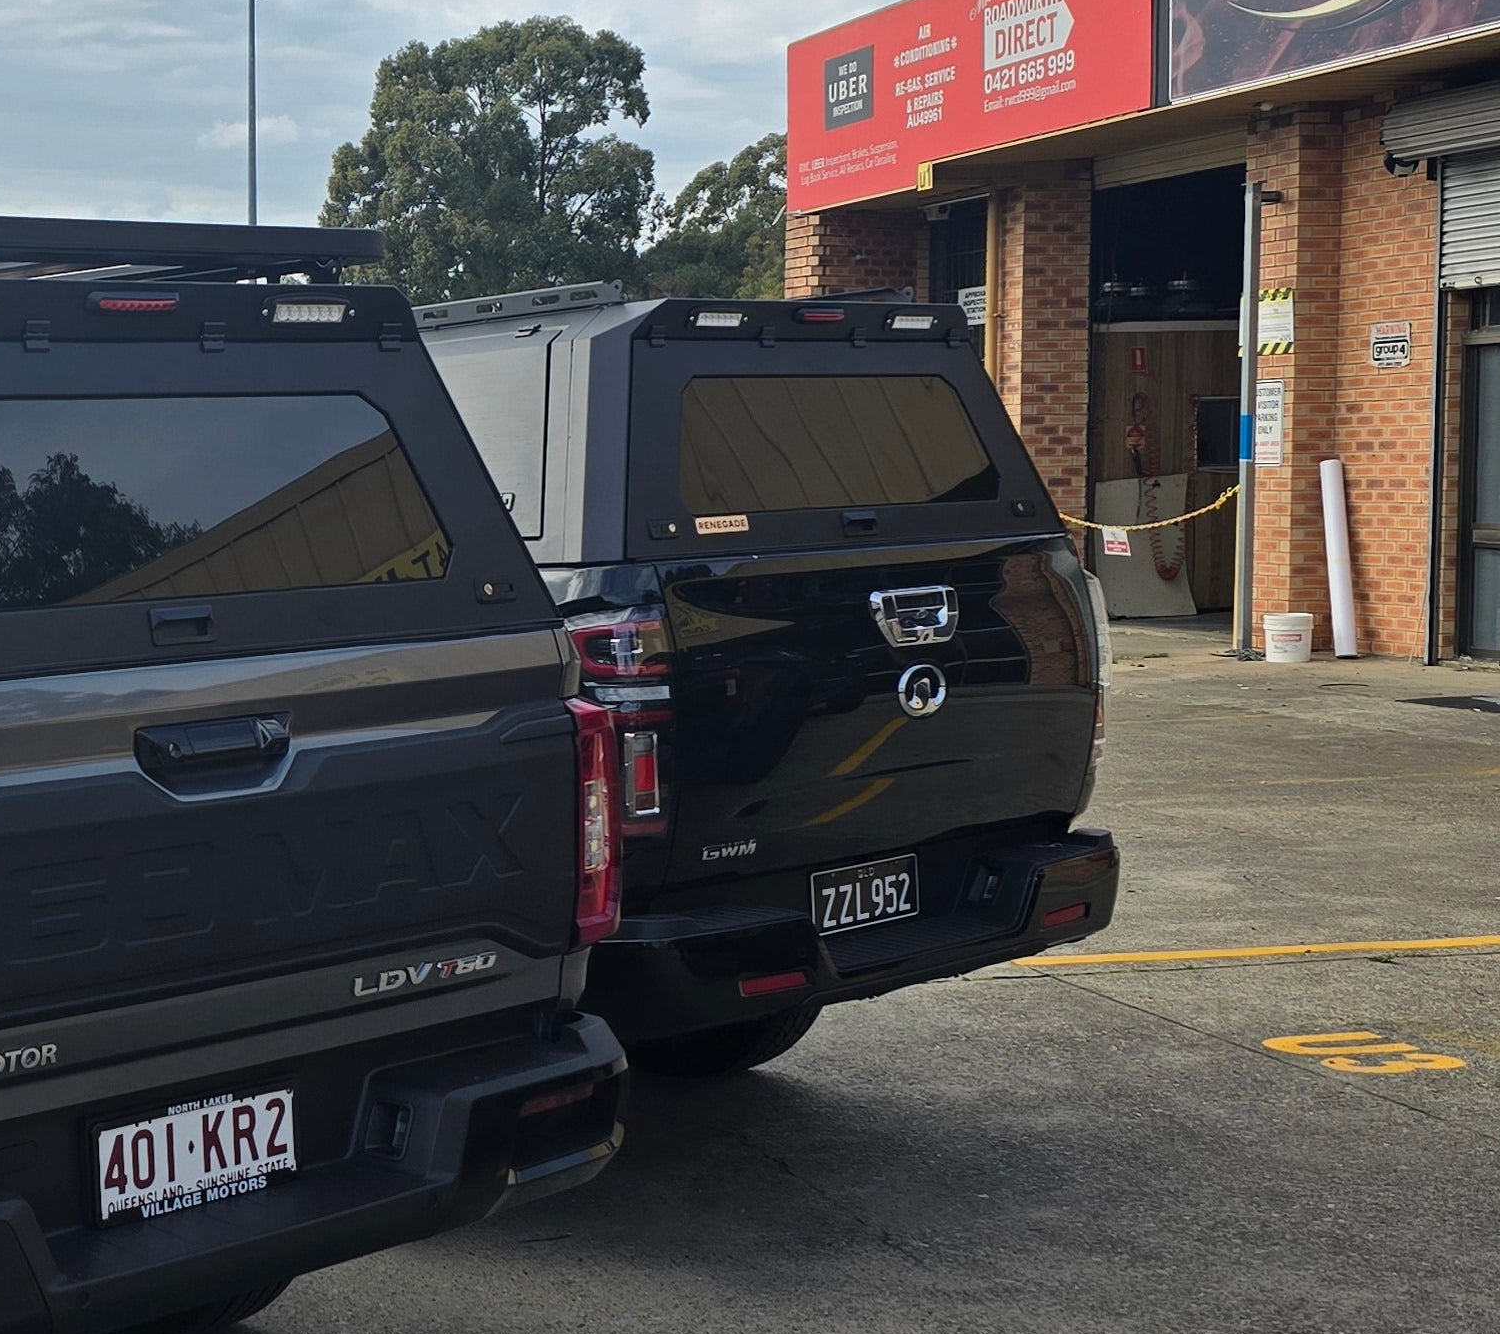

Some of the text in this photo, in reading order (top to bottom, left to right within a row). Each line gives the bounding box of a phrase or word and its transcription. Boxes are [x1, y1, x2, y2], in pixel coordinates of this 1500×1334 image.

[918, 24, 931, 40] AIR
[995, 11, 1057, 60] DIRECT
[900, 37, 951, 66] CONDITIONING
[838, 61, 857, 76] WE DO
[895, 66, 956, 97] RE-GAS, SERVICE
[984, 49, 1075, 94] 0421 665 999
[828, 74, 868, 103] UBER
[906, 90, 943, 113] & REPAIRS
[832, 99, 863, 117] INSPECTION
[906, 106, 942, 129] AU49961
[698, 519, 746, 530] RENEGADE
[254, 792, 525, 925] MAX
[702, 838, 757, 861] GWM
[822, 873, 911, 928] ZZL952
[354, 951, 497, 997] LDV T60
[168, 1093, 234, 1116] NORTH LAKES
[141, 1175, 268, 1218] VILLAGE MOTORS
